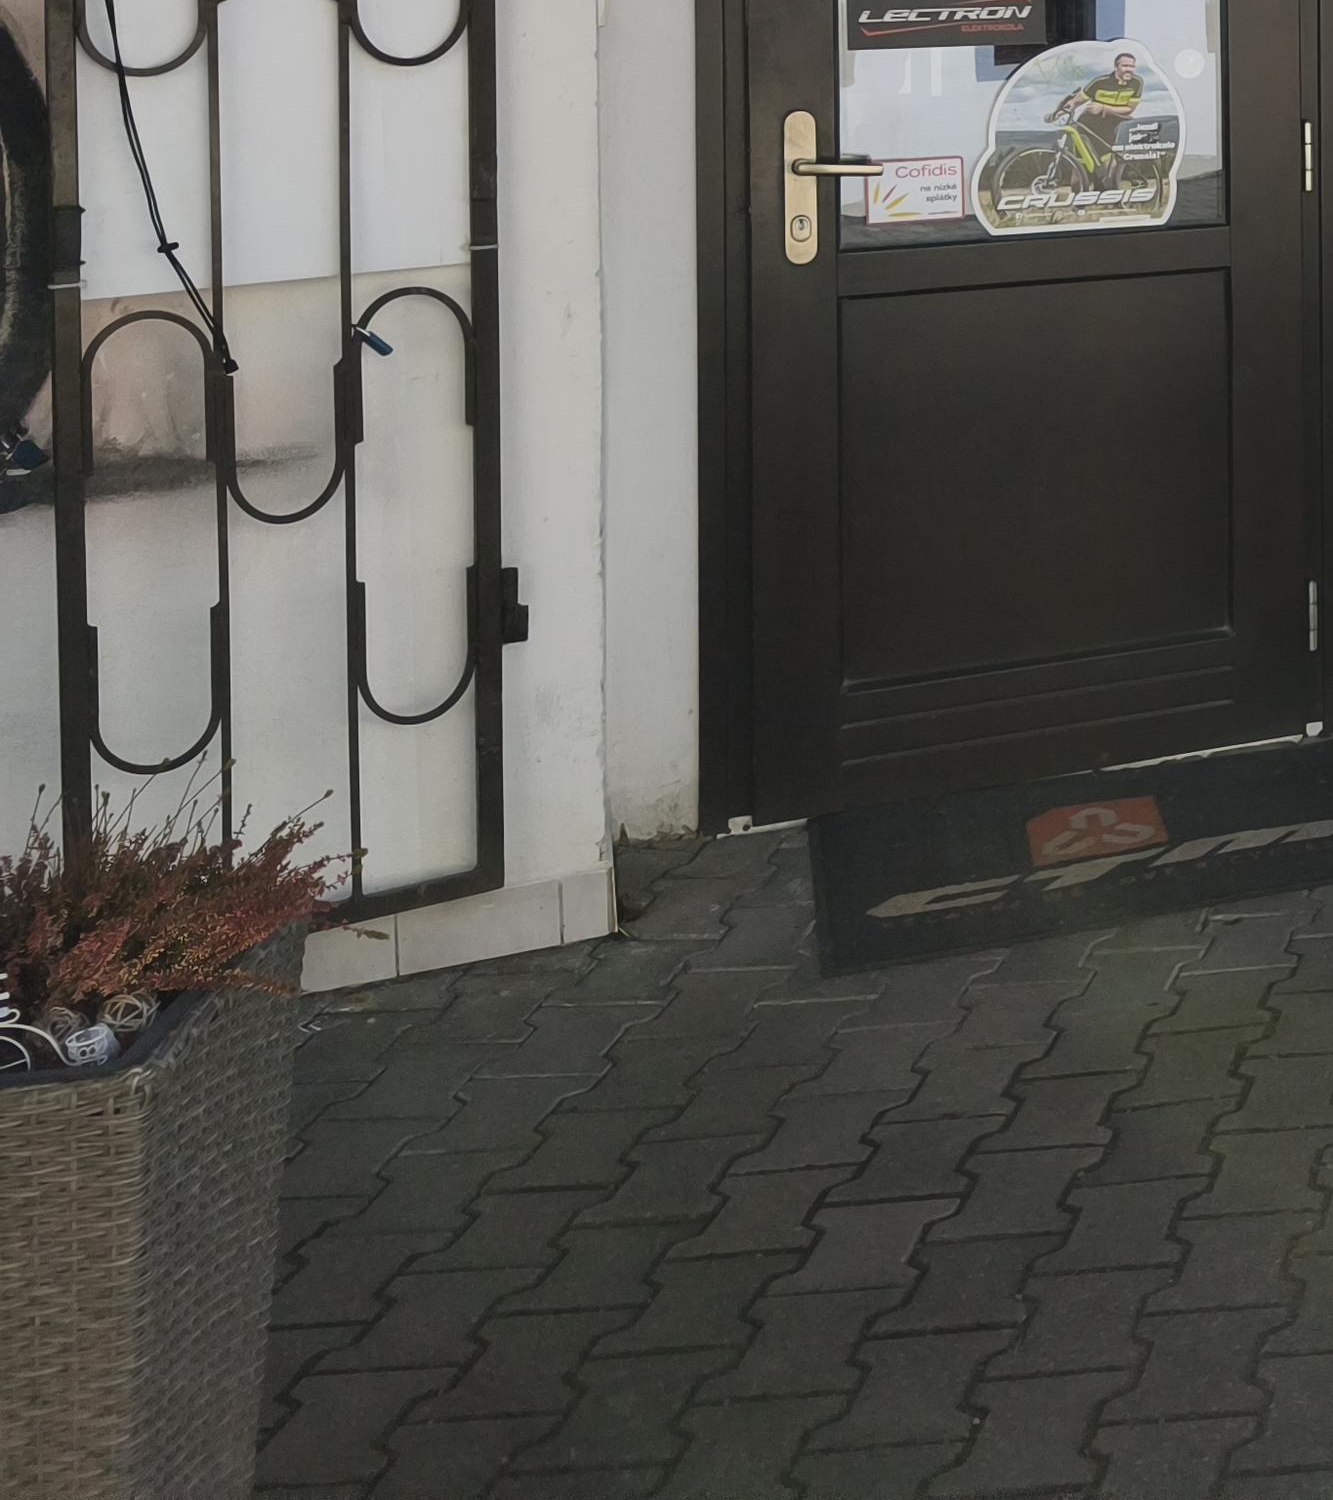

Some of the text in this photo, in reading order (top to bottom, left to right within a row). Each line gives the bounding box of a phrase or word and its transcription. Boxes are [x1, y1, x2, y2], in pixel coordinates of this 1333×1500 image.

[858, 5, 1033, 24] LECTRON
[895, 163, 958, 179] Cofidis
[925, 193, 958, 204] splátky
[996, 187, 1158, 211] CRUSSIS
